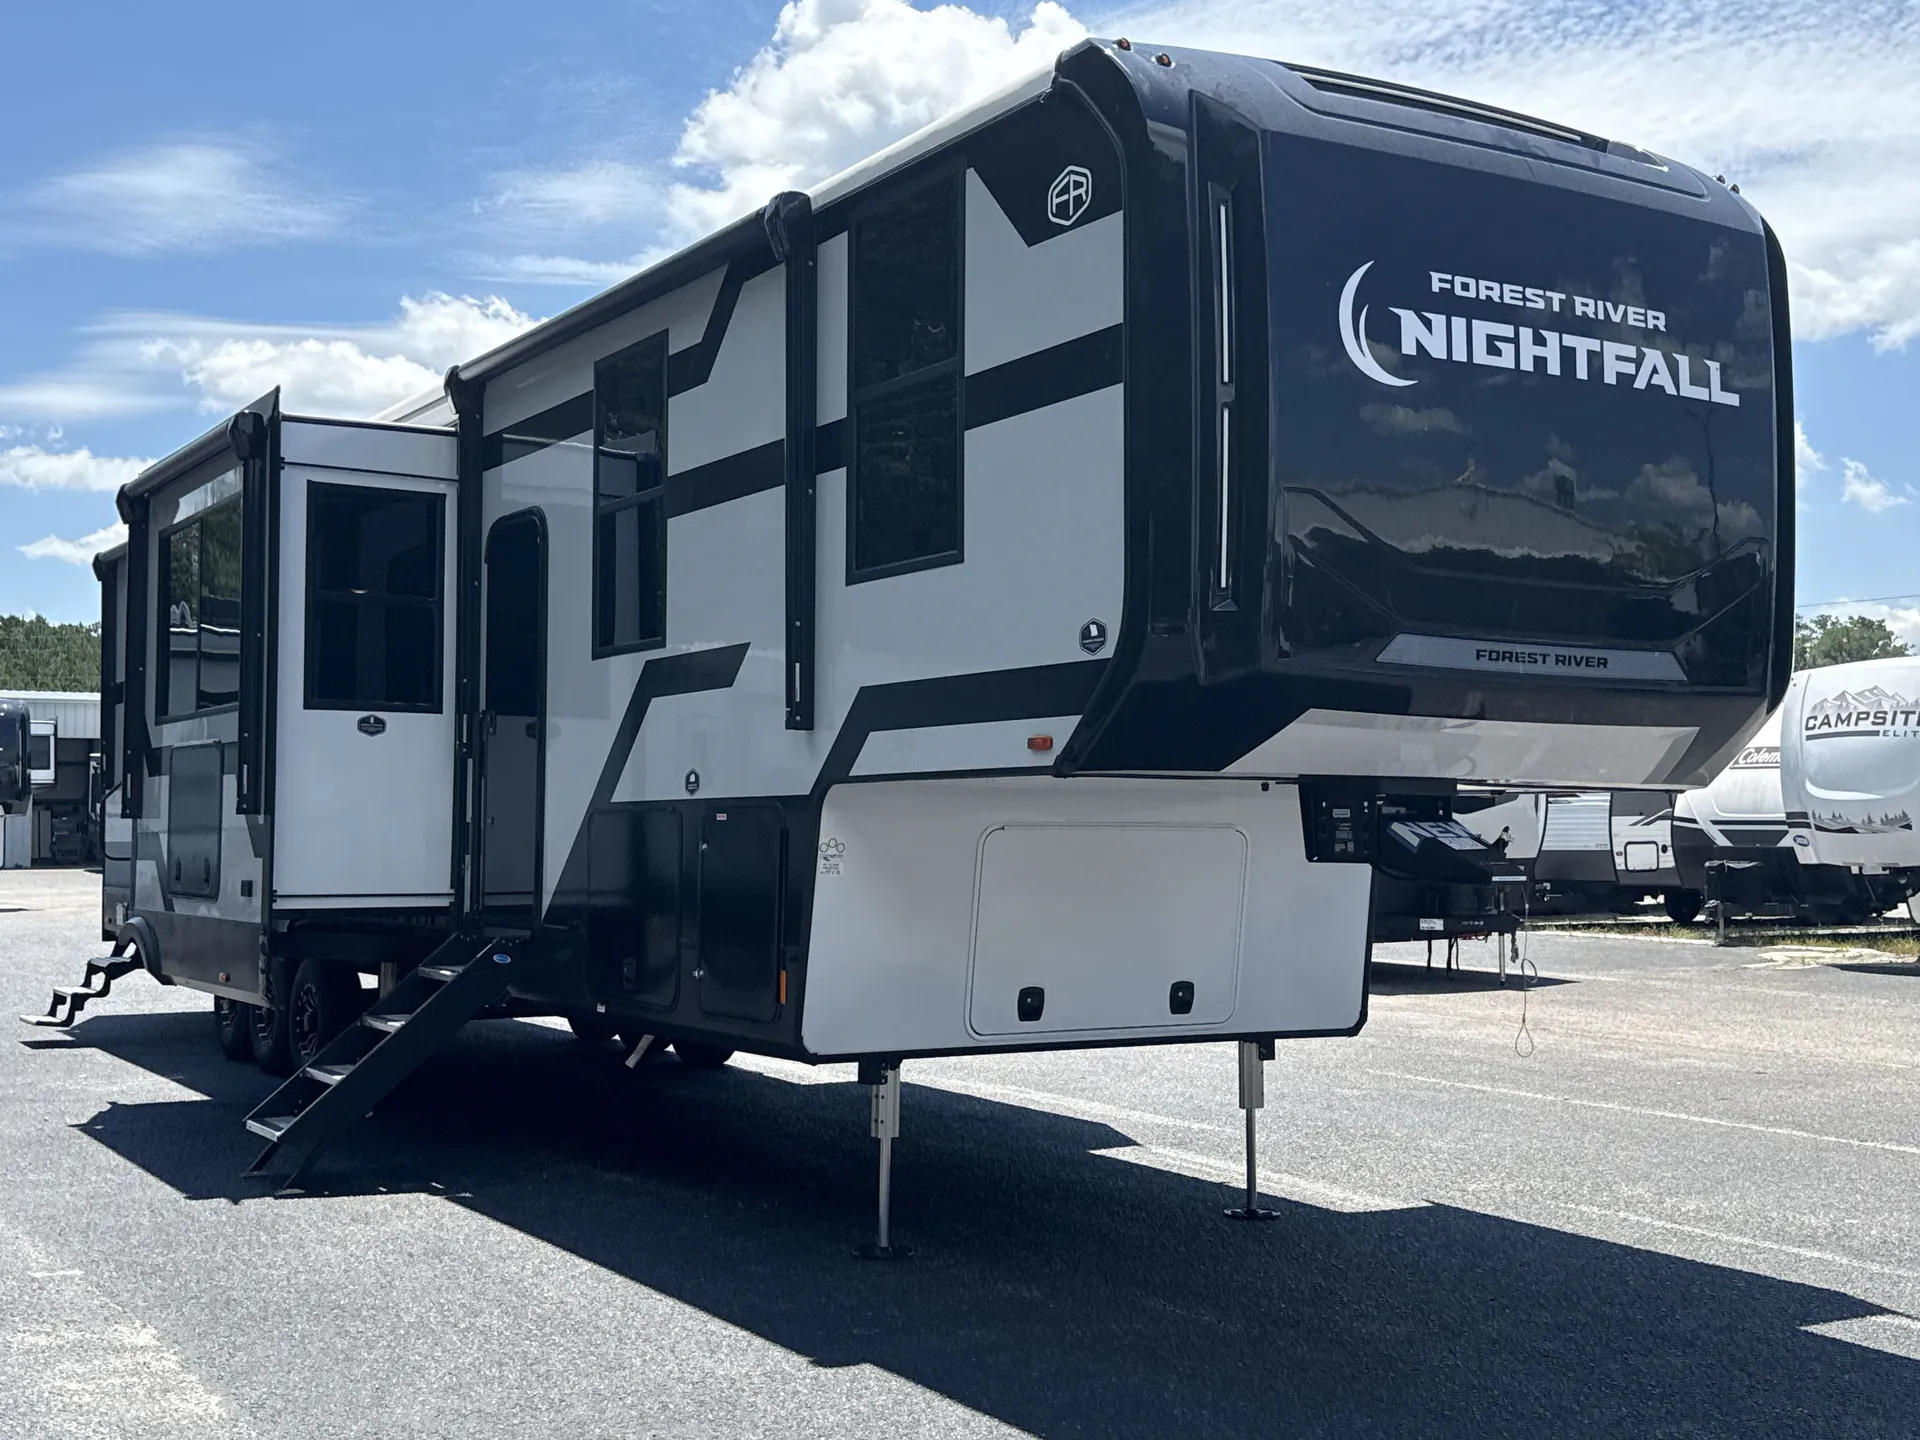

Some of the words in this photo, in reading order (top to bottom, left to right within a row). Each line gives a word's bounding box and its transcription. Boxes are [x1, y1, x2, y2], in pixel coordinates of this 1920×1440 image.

[1429, 271, 1566, 312] FOREST
[1572, 295, 1667, 332] RIVER
[1388, 306, 1740, 407] NIGHTFALL
[1476, 648, 1551, 665] FOREST
[1555, 653, 1609, 668] RIVER
